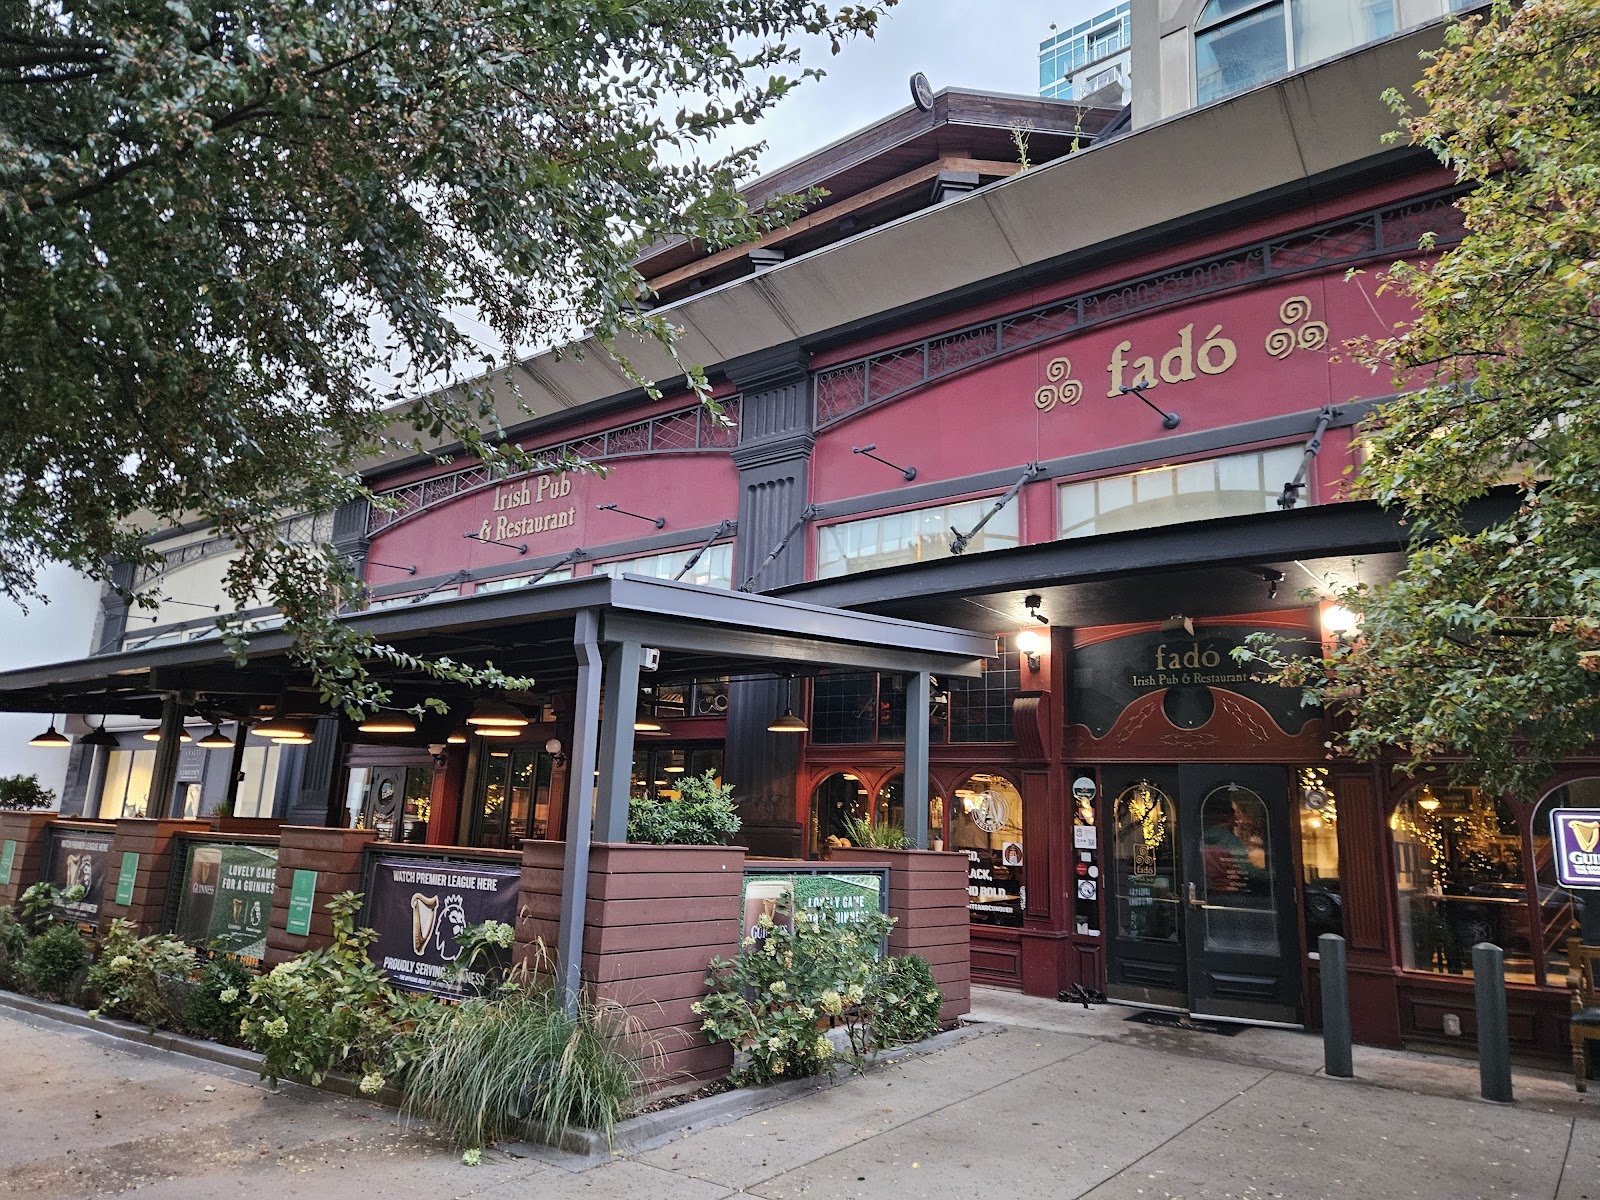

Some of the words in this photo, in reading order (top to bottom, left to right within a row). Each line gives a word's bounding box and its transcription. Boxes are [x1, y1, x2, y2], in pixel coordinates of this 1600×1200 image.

[1106, 322, 1237, 398] fadó
[493, 479, 531, 512] Irish
[535, 470, 571, 503] Pub
[479, 519, 493, 544] &
[495, 506, 576, 541] Restaurant
[1155, 643, 1221, 671] fadó
[1132, 675, 1156, 687] Irish
[1158, 674, 1179, 686] Pub
[1181, 673, 1191, 685] &
[1193, 672, 1247, 685] Restaurant
[229, 864, 255, 878] LOVELY
[256, 867, 277, 880] GAME
[393, 870, 415, 883] WATCH
[416, 872, 447, 887] PREMIER
[447, 875, 476, 890] LEAGUE
[477, 878, 498, 891] HERE
[968, 867, 993, 882] ACK,
[222, 878, 236, 890] FOR
[236, 880, 242, 891] A
[243, 880, 278, 894] GUINNES
[383, 956, 416, 974] PROUDLY
[415, 962, 446, 978] SERVING
